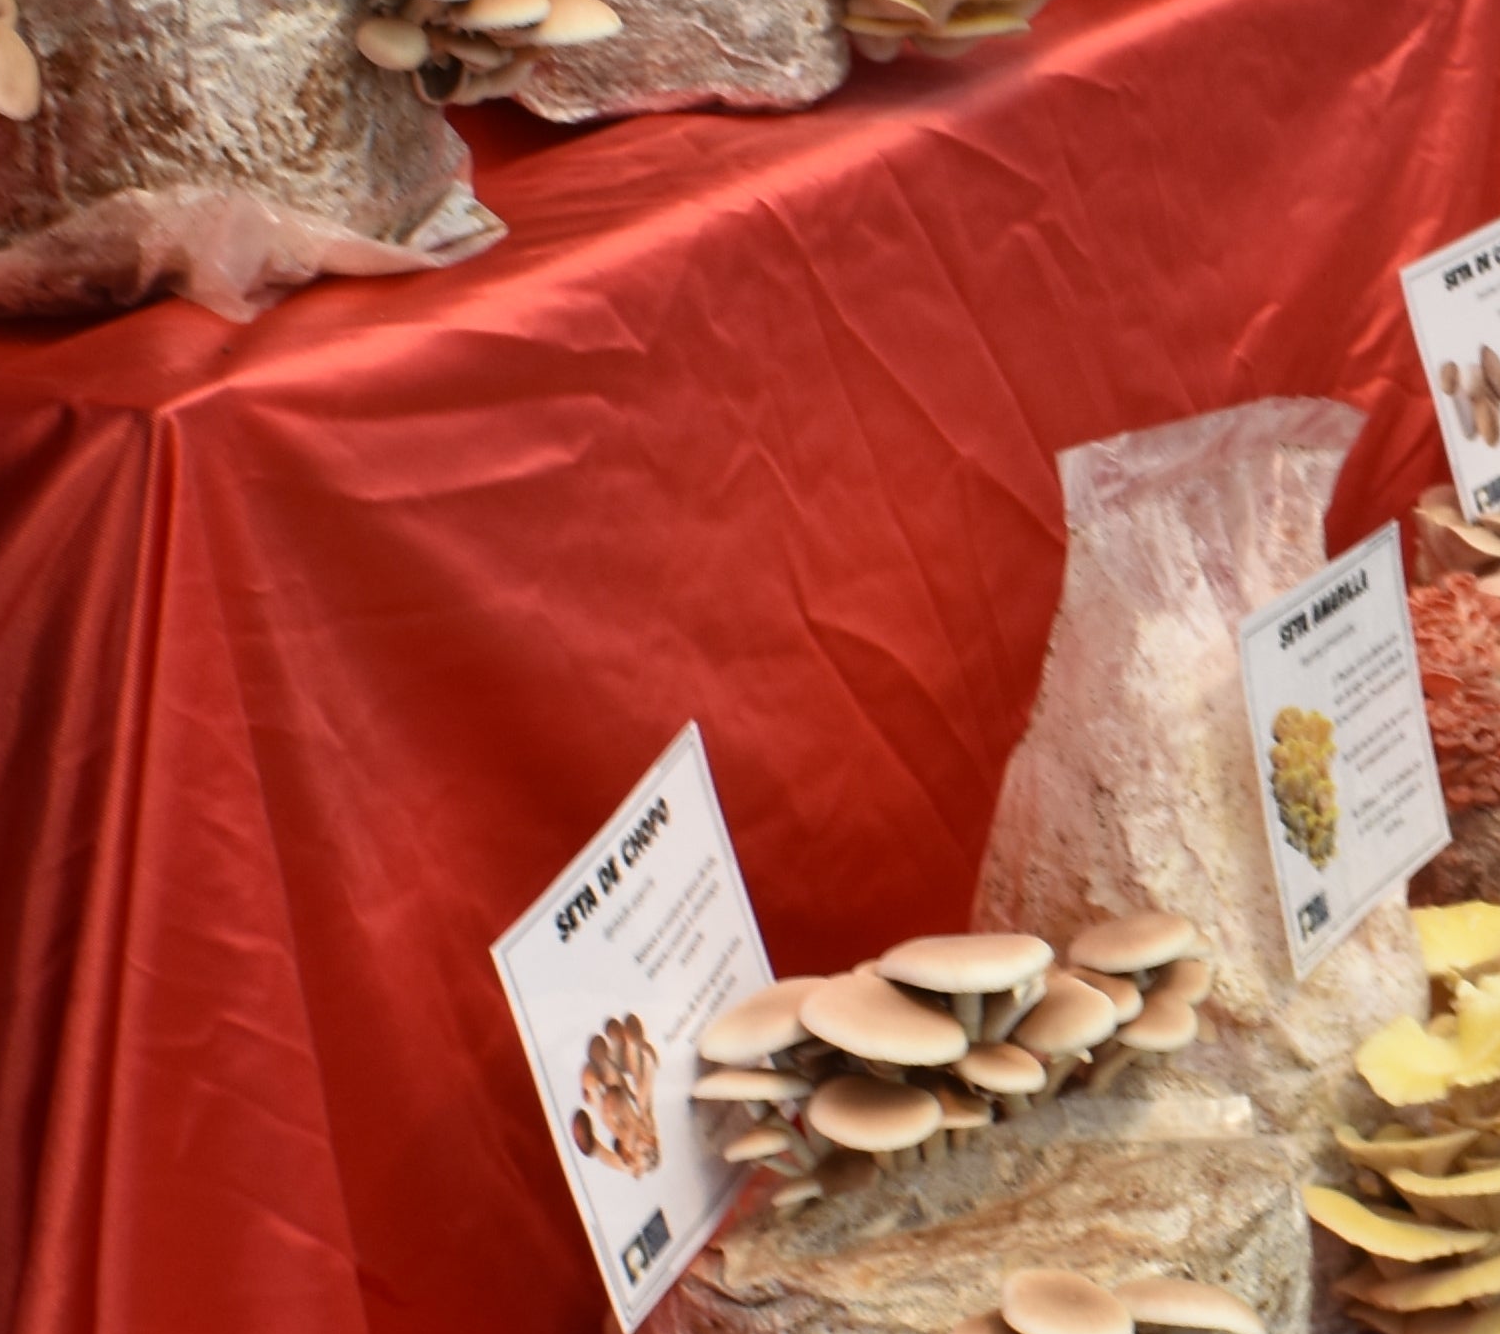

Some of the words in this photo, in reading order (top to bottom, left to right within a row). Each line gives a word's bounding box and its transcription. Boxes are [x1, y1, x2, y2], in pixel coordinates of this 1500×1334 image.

[1443, 262, 1474, 291] SETA
[1474, 251, 1492, 274] DE
[1279, 612, 1311, 651] SETA
[556, 884, 598, 943] SETA
[597, 855, 621, 895] DE
[620, 796, 670, 868] CHOPO
